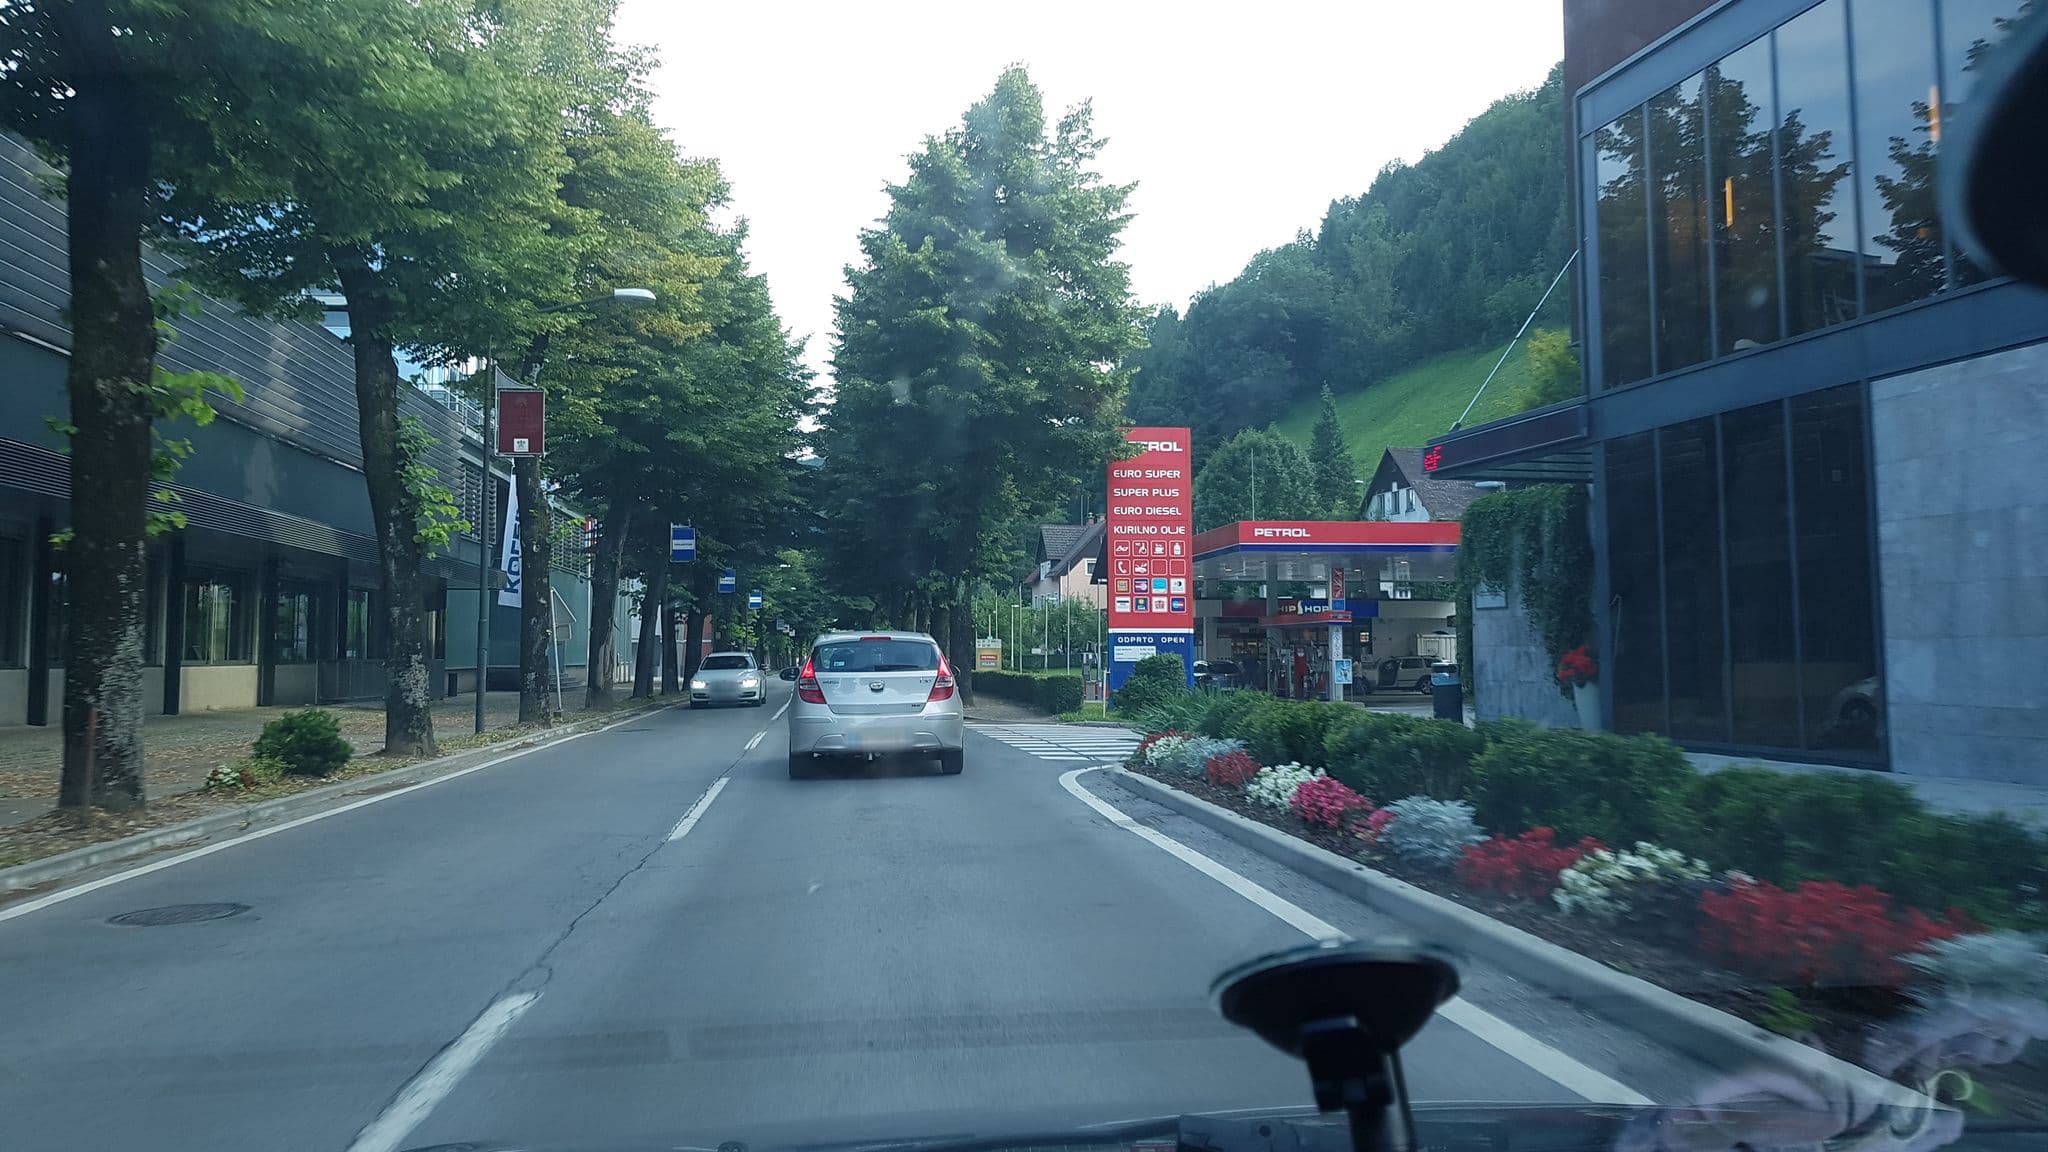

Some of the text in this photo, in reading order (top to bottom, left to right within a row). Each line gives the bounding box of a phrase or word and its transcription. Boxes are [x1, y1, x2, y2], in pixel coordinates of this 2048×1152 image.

[1113, 469, 1181, 479] EURO SUPER
[1113, 488, 1180, 497] SUPER PLUS
[1113, 506, 1182, 516] EURO DIESEL
[1113, 526, 1186, 535] KURILNO OLJE
[1254, 528, 1311, 537] PETROL
[1160, 636, 1185, 644] OPEN
